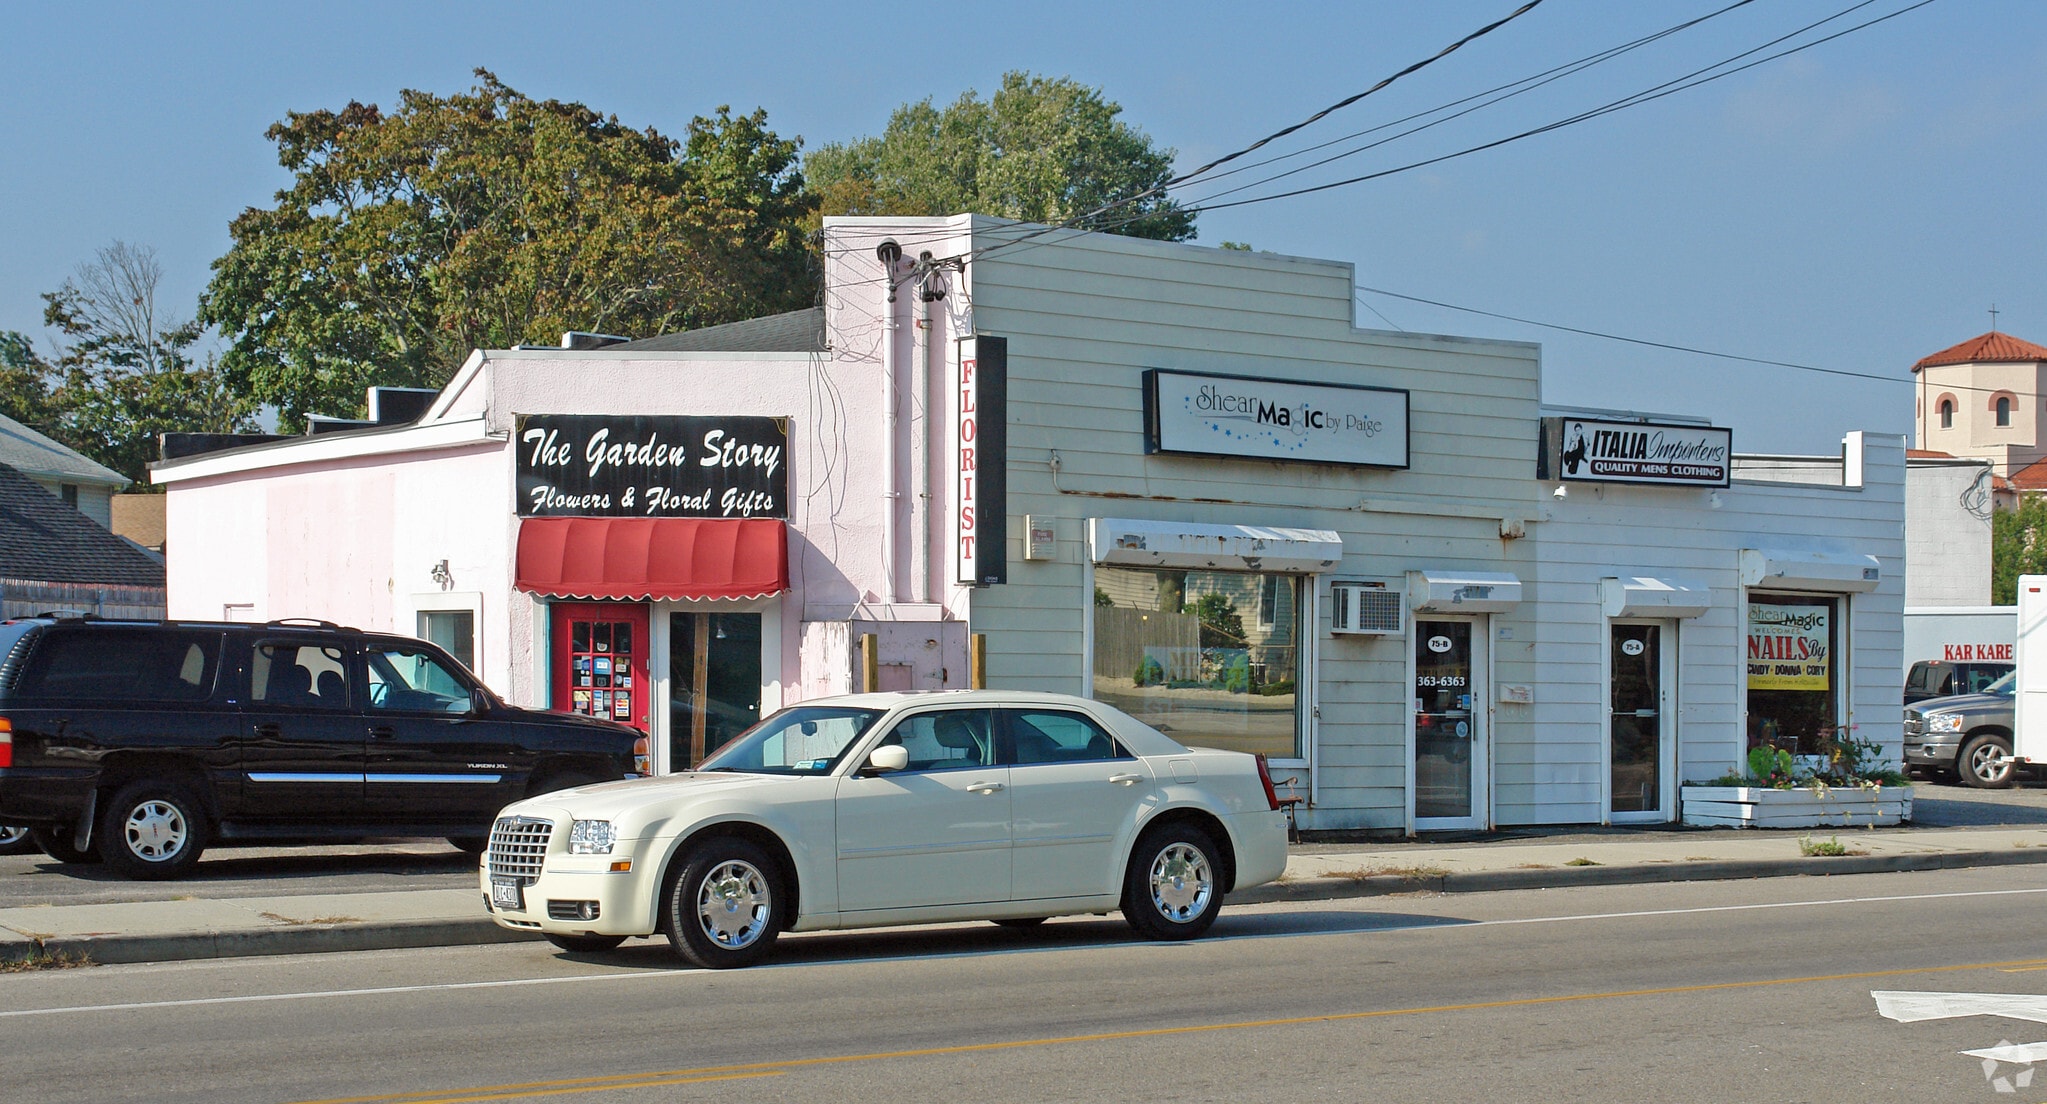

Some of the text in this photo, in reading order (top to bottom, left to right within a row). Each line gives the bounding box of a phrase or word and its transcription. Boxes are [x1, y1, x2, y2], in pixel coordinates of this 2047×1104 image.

[1196, 385, 1382, 438] Shear Magic by Paige
[523, 428, 781, 478] The Garden Story
[961, 360, 976, 559] FLORIST
[1592, 430, 1725, 464] ITALIA Importers
[1594, 462, 1720, 477] QUALITY MENS CLOTHING
[530, 486, 774, 517] Flowers & Floral Gifts
[1748, 605, 1824, 631] Shear Magic
[1431, 640, 1448, 648] 75-B
[1747, 635, 1827, 662] NAILS By
[1944, 643, 2013, 661] KAR KARE
[1418, 676, 1465, 687] 363-6363
[1806, 664, 1826, 676] CORY
